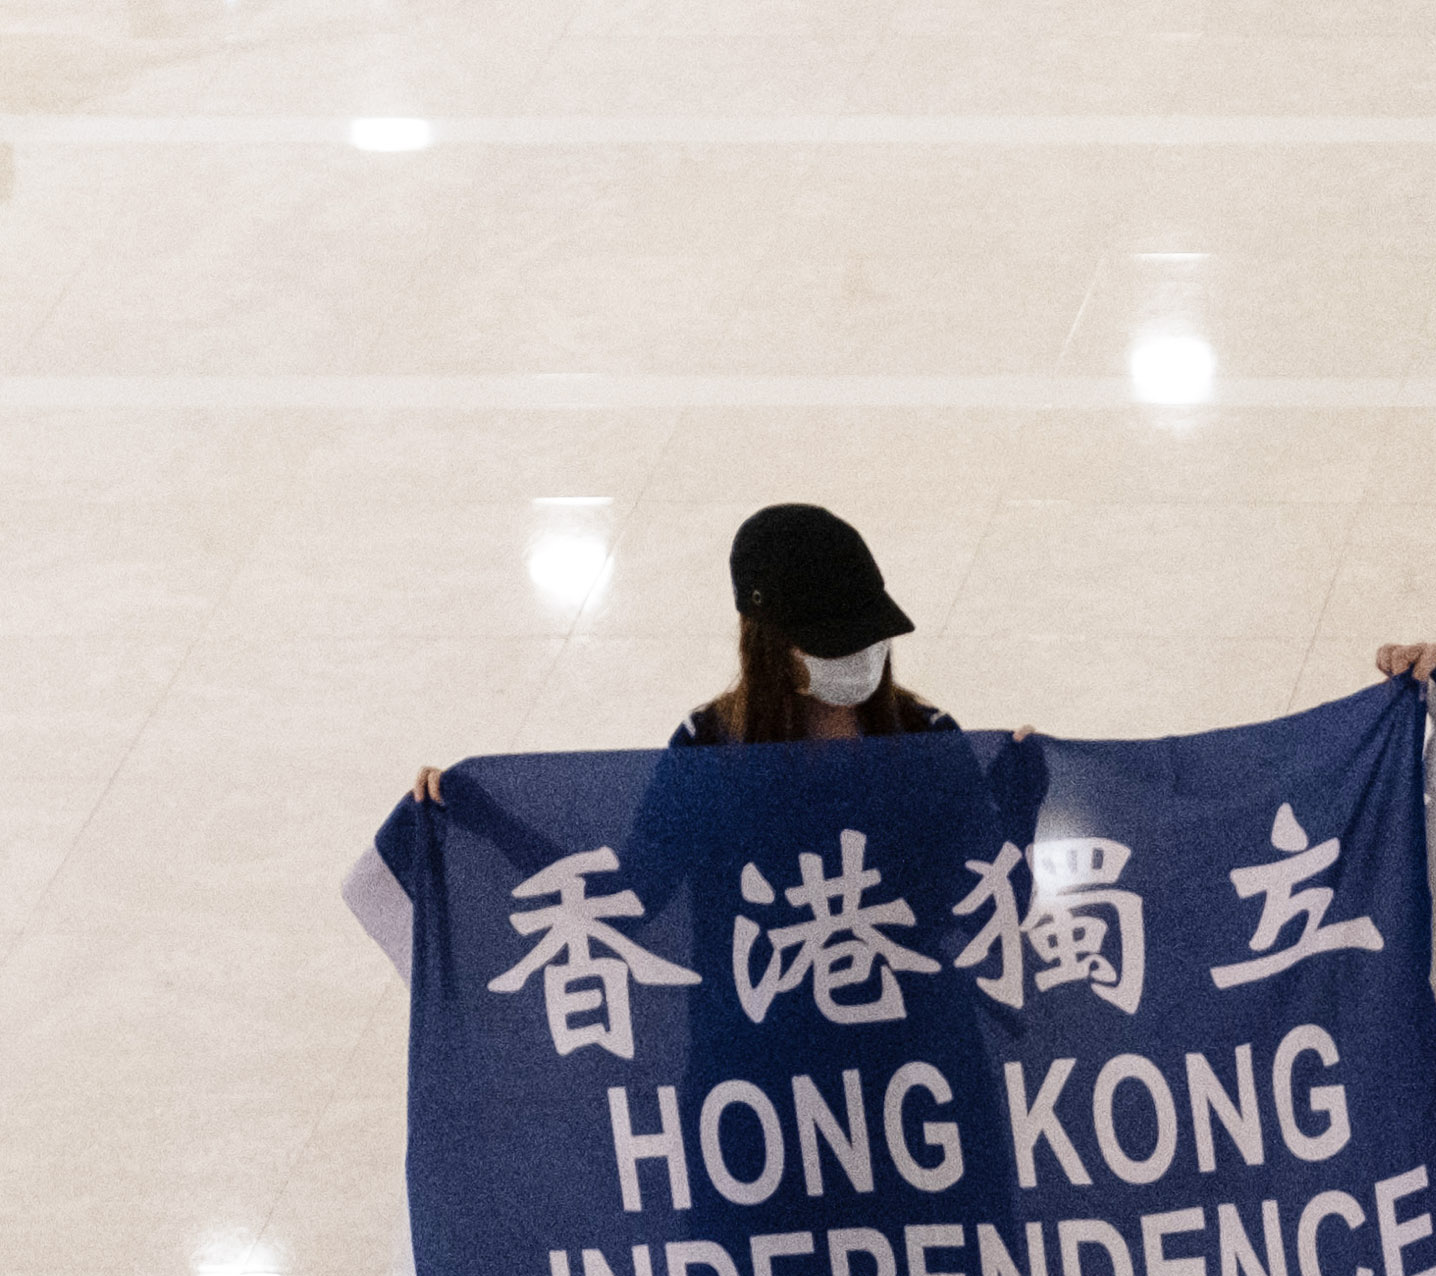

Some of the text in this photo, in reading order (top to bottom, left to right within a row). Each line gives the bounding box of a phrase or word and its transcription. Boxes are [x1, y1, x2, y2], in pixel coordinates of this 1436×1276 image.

[489, 803, 1384, 1060] 香港獨立
[608, 1025, 1352, 1211] HONG KONG
